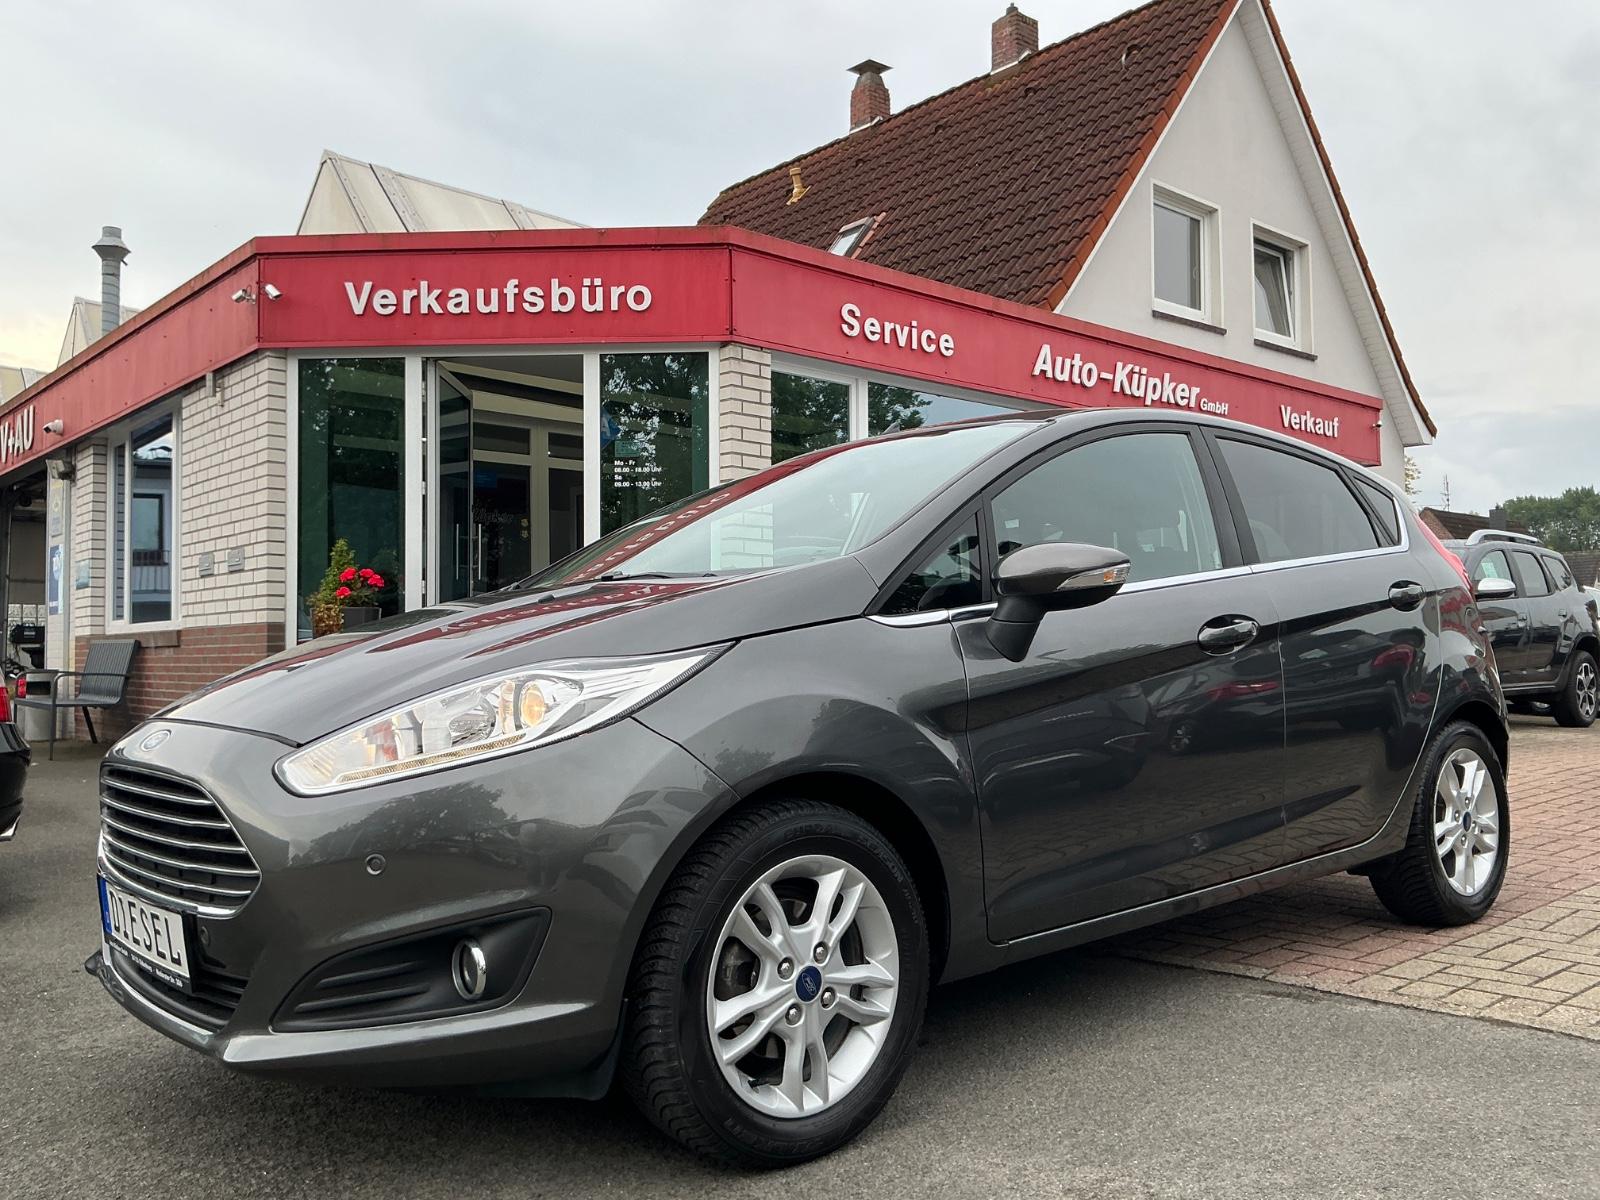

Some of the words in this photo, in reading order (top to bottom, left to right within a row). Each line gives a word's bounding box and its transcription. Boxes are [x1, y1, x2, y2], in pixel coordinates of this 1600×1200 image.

[344, 277, 653, 317] Verkaufsbüro
[839, 302, 956, 359] Service
[1031, 343, 1201, 410] Auto-Küpker
[1200, 397, 1230, 416] GmbH
[1279, 404, 1341, 440] Verkauf
[108, 889, 183, 967] DIESEL
